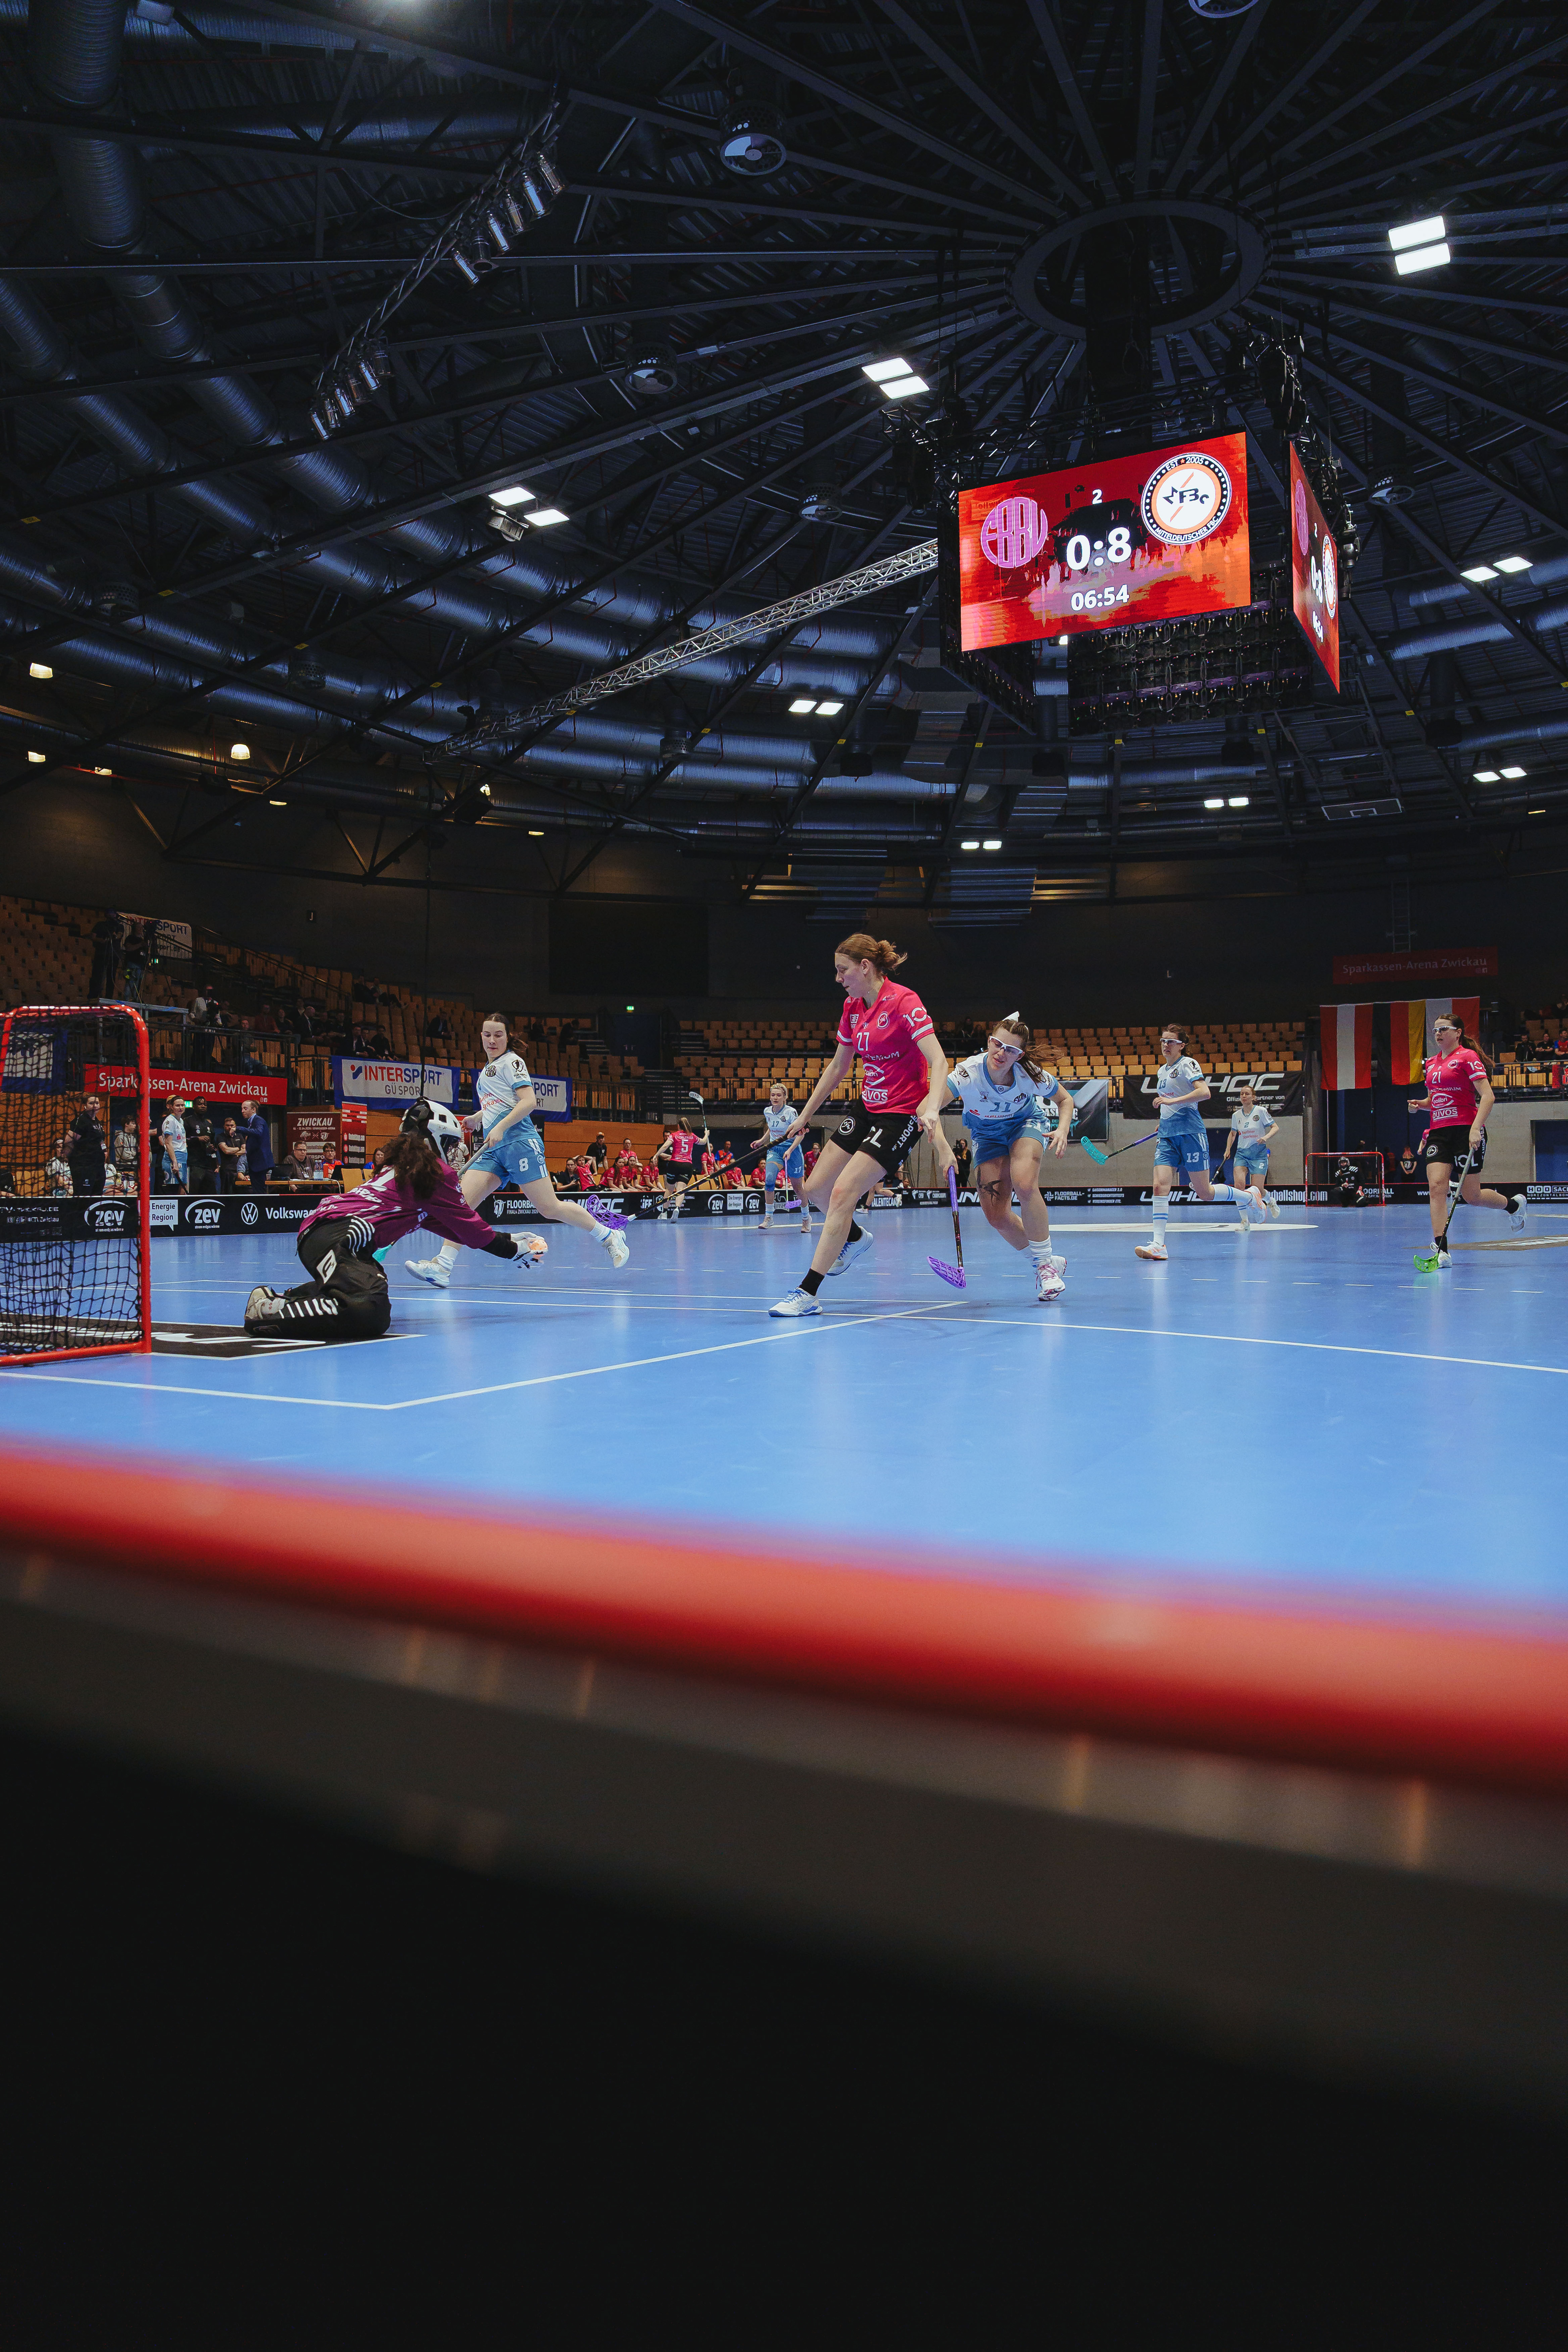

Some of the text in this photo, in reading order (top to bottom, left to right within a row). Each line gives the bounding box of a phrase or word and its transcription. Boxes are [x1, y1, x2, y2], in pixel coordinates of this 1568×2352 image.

[1165, 457, 1205, 471] EST. 2005
[1092, 489, 1102, 504] 2
[1154, 516, 1219, 541] MITTELDEUTSCHER FBC
[1066, 527, 1131, 570] 0:8
[1071, 584, 1129, 611] 06:54
[1343, 956, 1487, 976] Sparkassen-Arena Zwickau
[857, 1032, 870, 1051] 27
[1140, 1073, 1285, 1094] UHOC
[1159, 1078, 1167, 1089] 13
[1432, 1071, 1441, 1084] 21
[99, 1072, 268, 1097] Sparkssen-Arena Zwickau
[399, 1085, 421, 1096] SPOR
[989, 1102, 1011, 1113] 11
[1432, 1108, 1458, 1119] DÜVOS
[297, 1118, 333, 1126] ZWICKAU
[681, 1139, 688, 1152] 5
[1187, 1152, 1200, 1163] 13
[519, 1157, 529, 1172] 8
[794, 1166, 802, 1174] 17
[712, 1199, 724, 1210] zev
[749, 1199, 760, 1209] zev
[95, 1210, 125, 1226] zev
[152, 1214, 174, 1222] Region
[194, 1208, 220, 1224] zev
